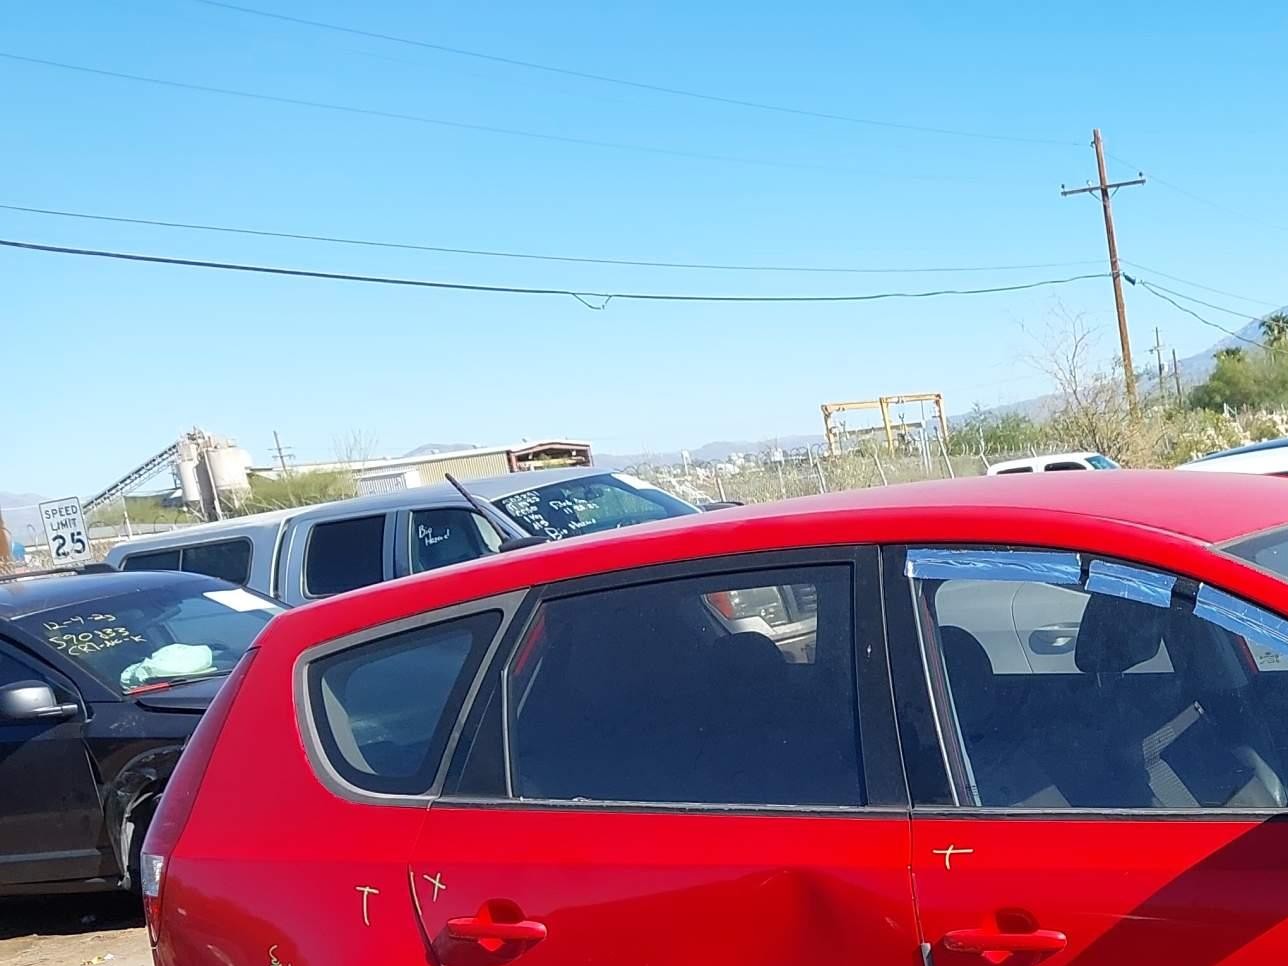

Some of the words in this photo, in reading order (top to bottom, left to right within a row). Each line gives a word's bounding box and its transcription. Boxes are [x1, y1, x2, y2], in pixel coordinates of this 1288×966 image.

[44, 504, 78, 519] SPEED
[50, 518, 77, 531] LIMIT
[52, 531, 86, 557] 25
